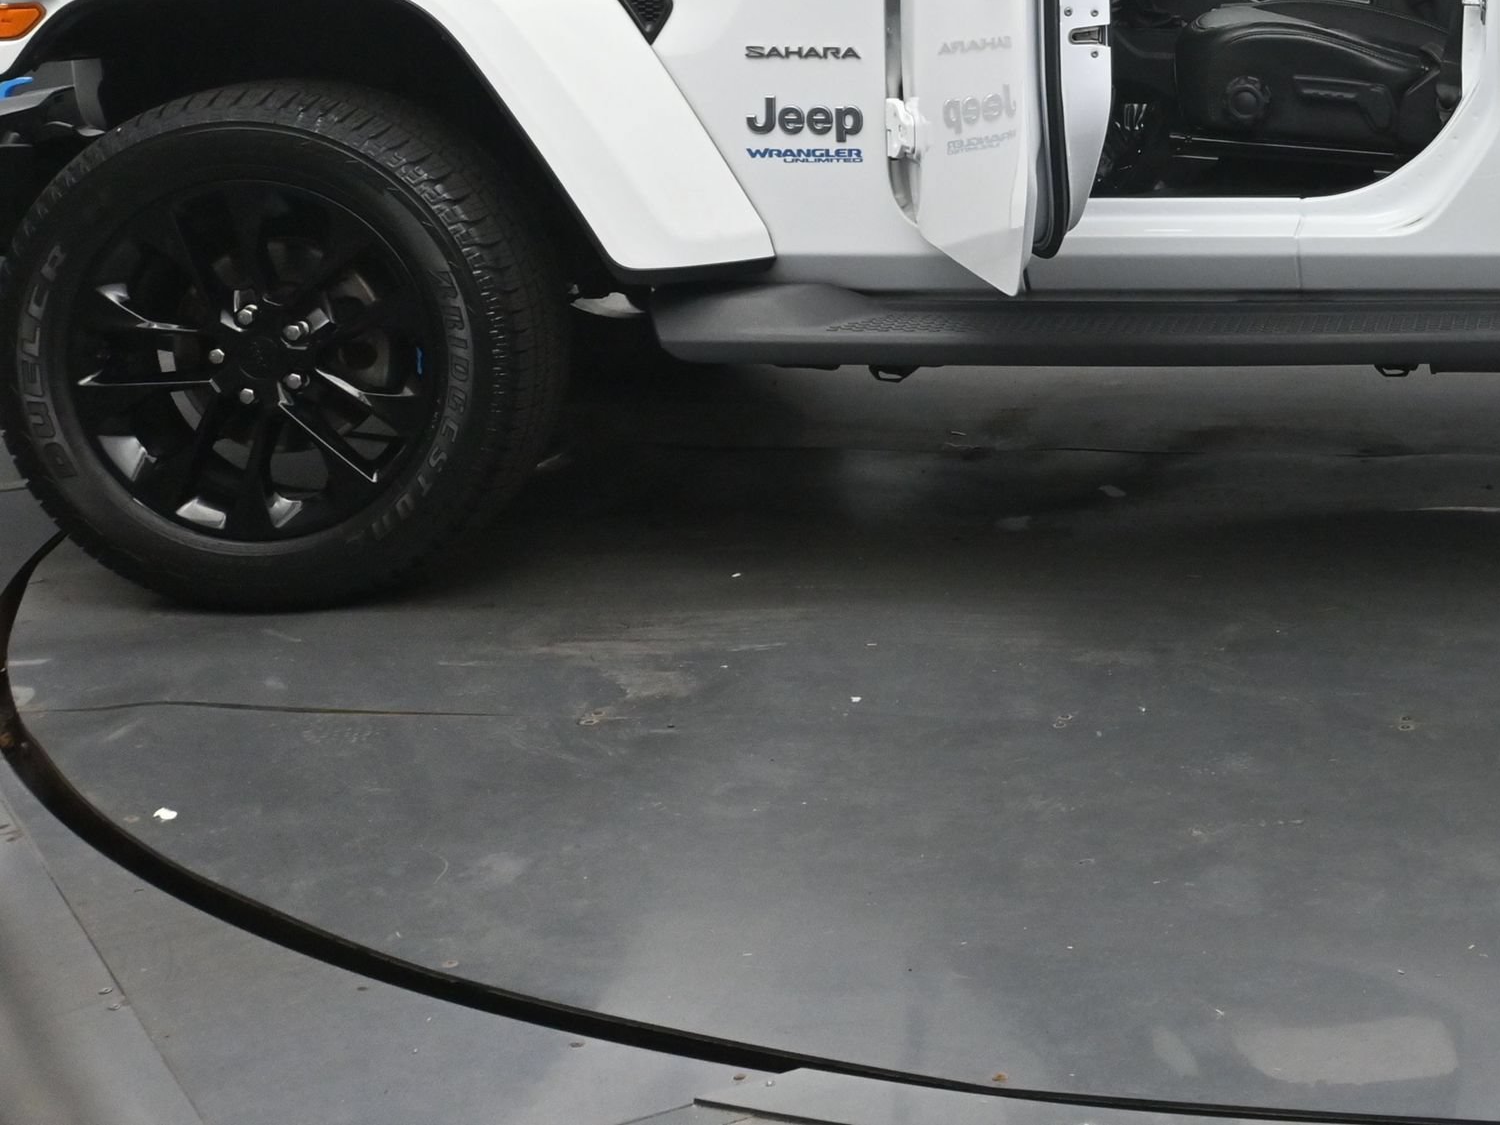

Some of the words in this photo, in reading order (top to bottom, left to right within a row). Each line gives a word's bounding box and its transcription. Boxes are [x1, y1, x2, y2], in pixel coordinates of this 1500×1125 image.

[744, 45, 862, 60] SAHARA
[745, 94, 864, 143] Jeep
[745, 147, 863, 158] WRANGLER
